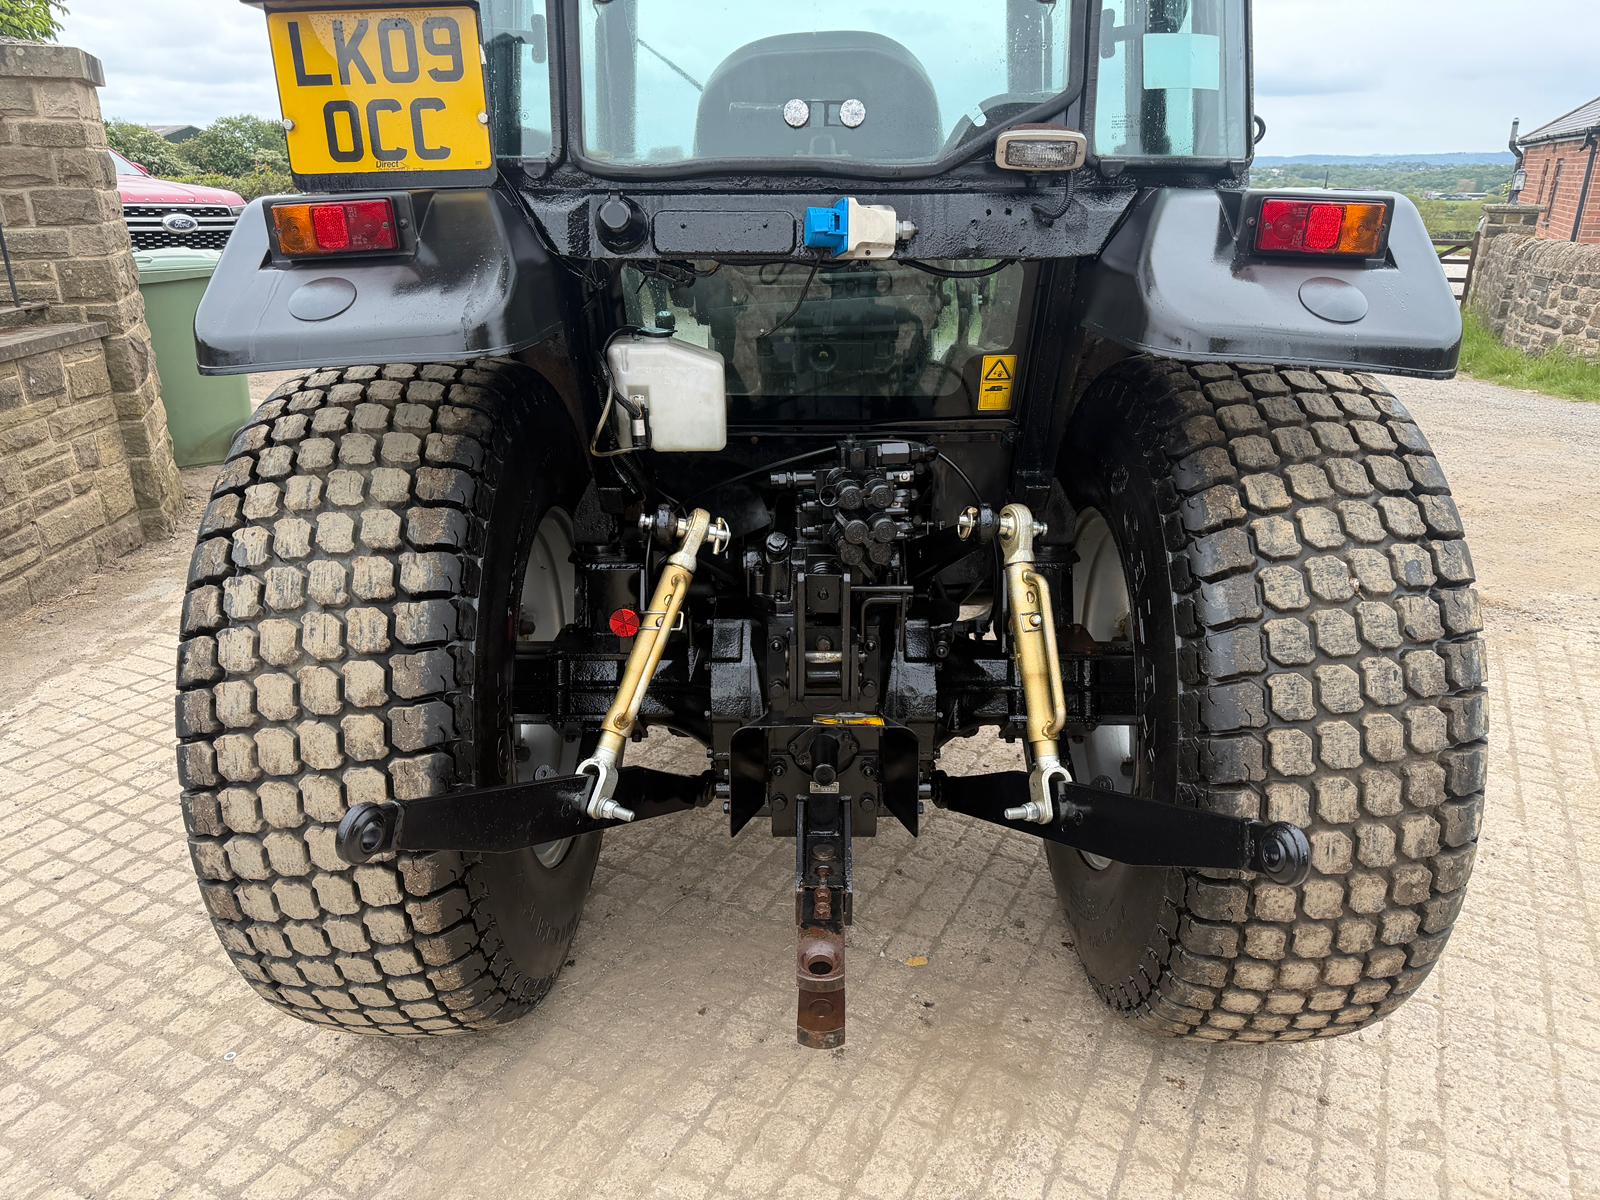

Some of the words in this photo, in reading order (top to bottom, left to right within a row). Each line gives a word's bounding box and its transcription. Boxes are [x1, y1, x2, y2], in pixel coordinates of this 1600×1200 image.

[287, 16, 465, 87] LK09
[323, 97, 451, 163] OCC
[376, 160, 399, 169] Direct
[174, 219, 191, 229] Ford
